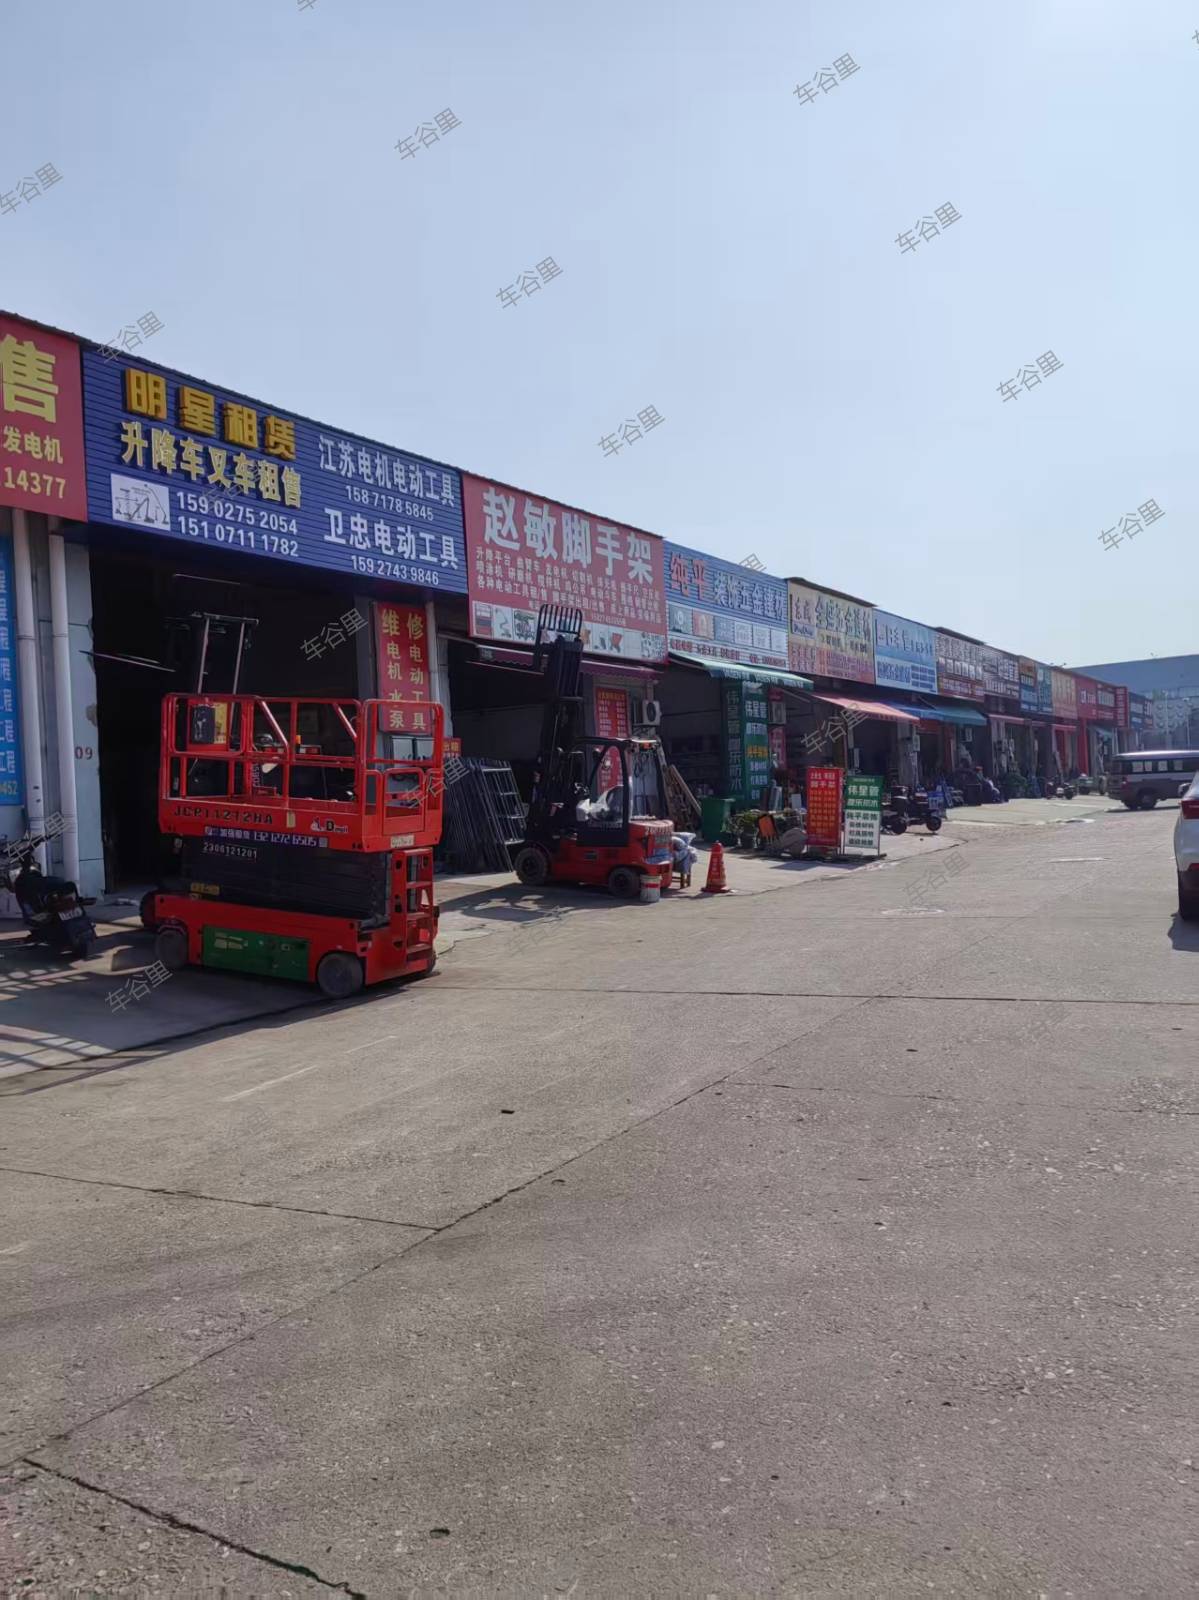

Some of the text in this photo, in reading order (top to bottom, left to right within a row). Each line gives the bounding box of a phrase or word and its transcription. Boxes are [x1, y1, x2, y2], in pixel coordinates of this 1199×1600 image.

[0, 334, 59, 423] 售
[3, 426, 64, 465] 发电机
[125, 367, 297, 460] 明星租赁
[121, 422, 302, 508] 升降车叉车租售
[318, 434, 456, 507] 江苏电机电动工具
[176, 491, 298, 535] 159 0275 2054
[346, 485, 434, 521] 158 7178 5845
[483, 487, 654, 584] 赵敏脚手架
[178, 516, 299, 558] 151 0711 1782
[323, 508, 458, 570] 卫忠电动工具
[351, 555, 439, 586] 159 2743 9846
[382, 609, 424, 640] 维修
[387, 641, 405, 729] 电机水泵
[409, 644, 426, 730] 电动工具
